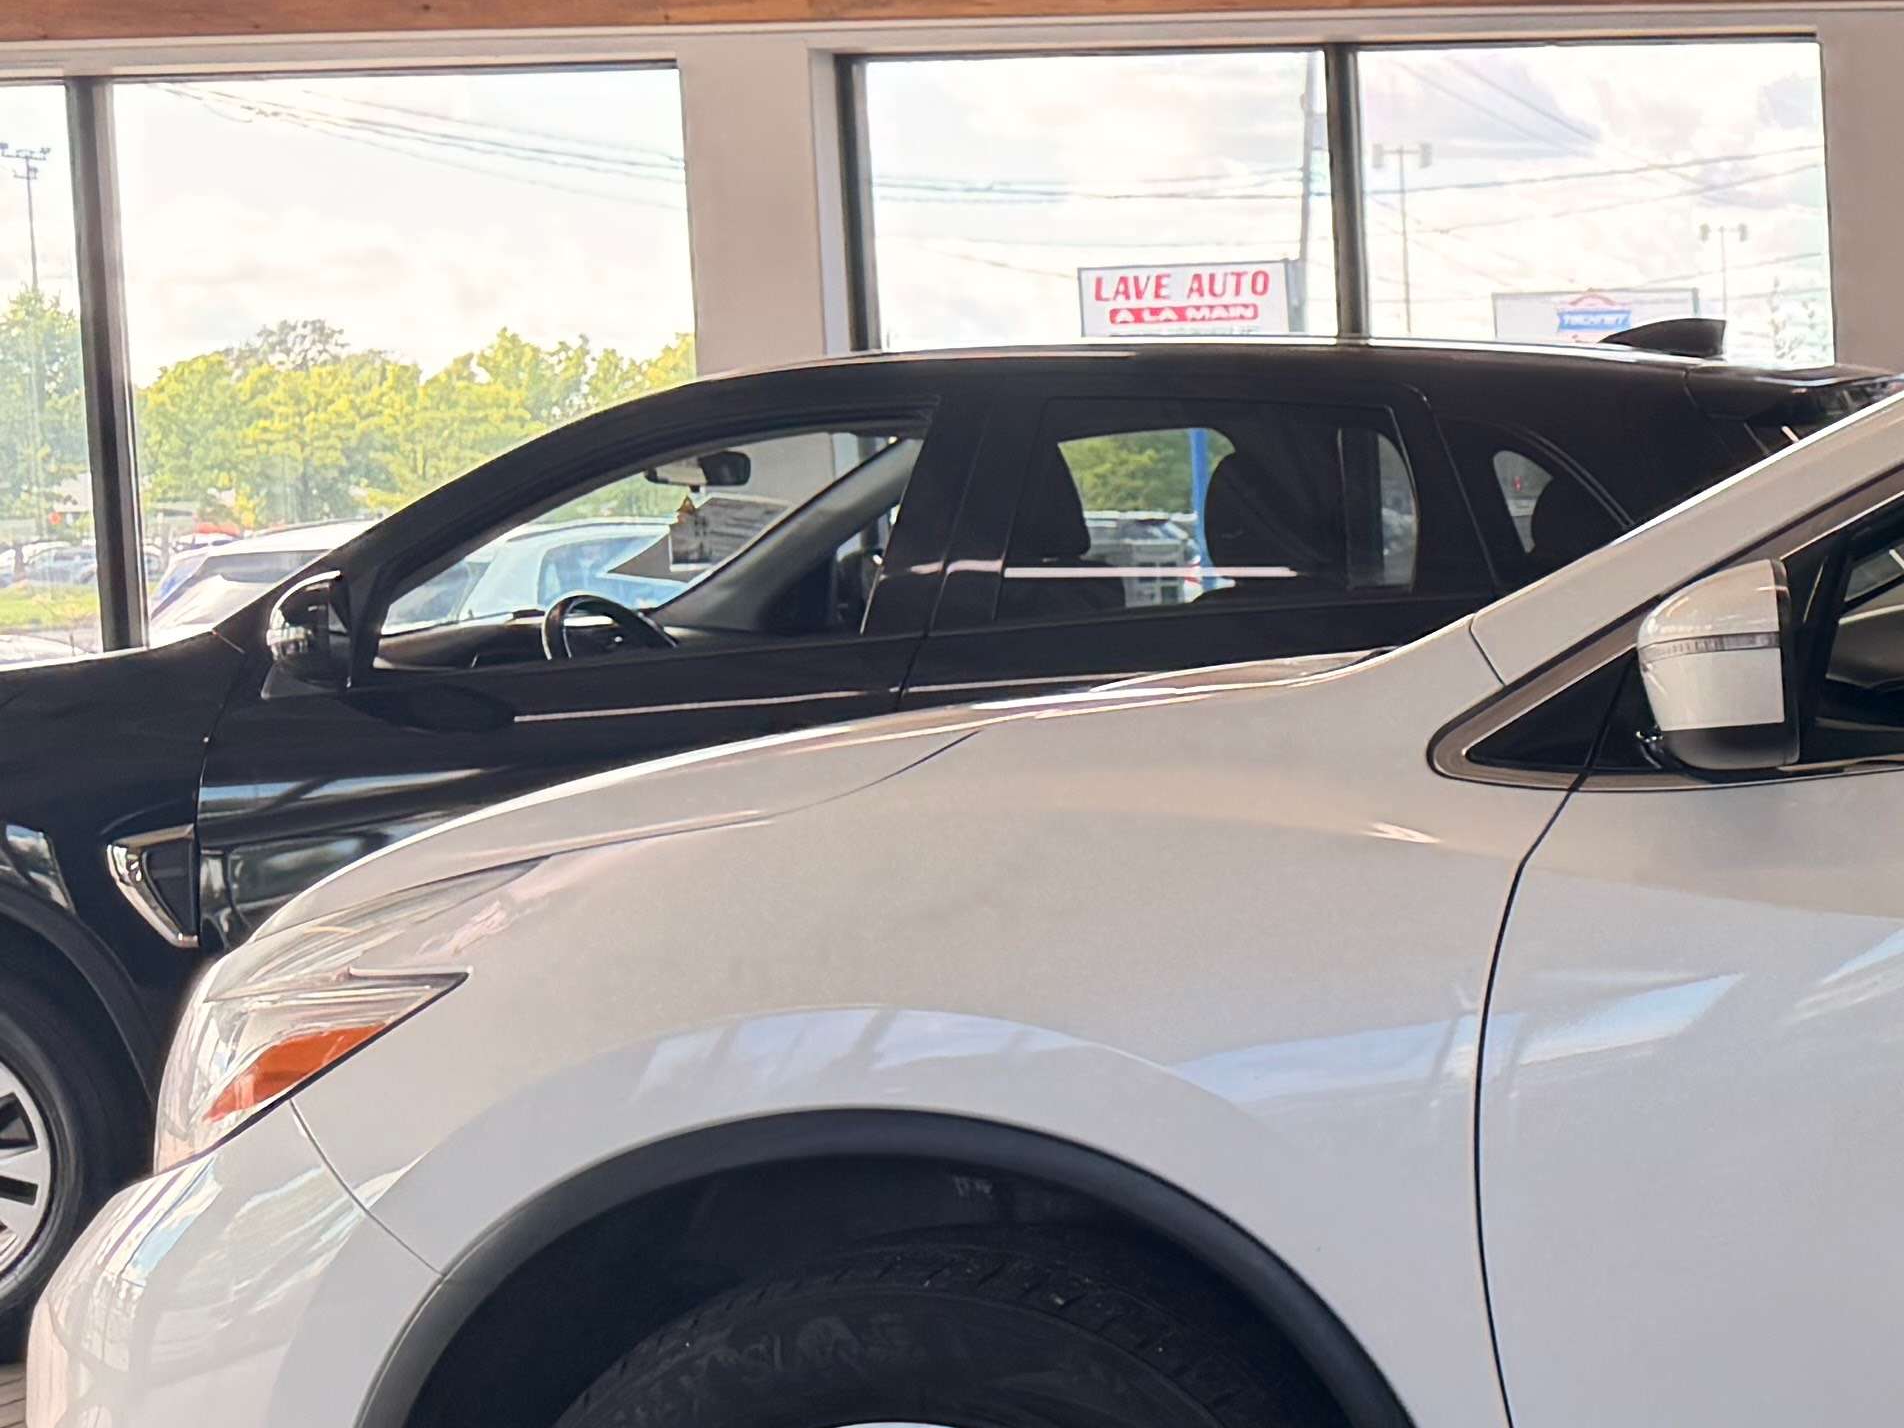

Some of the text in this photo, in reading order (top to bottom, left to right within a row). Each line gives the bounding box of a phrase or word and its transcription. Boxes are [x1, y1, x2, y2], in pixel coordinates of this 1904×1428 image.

[1095, 270, 1270, 302] LAVE AUTO
[1141, 306, 1179, 323] LA
[1185, 304, 1254, 322] MAIN
